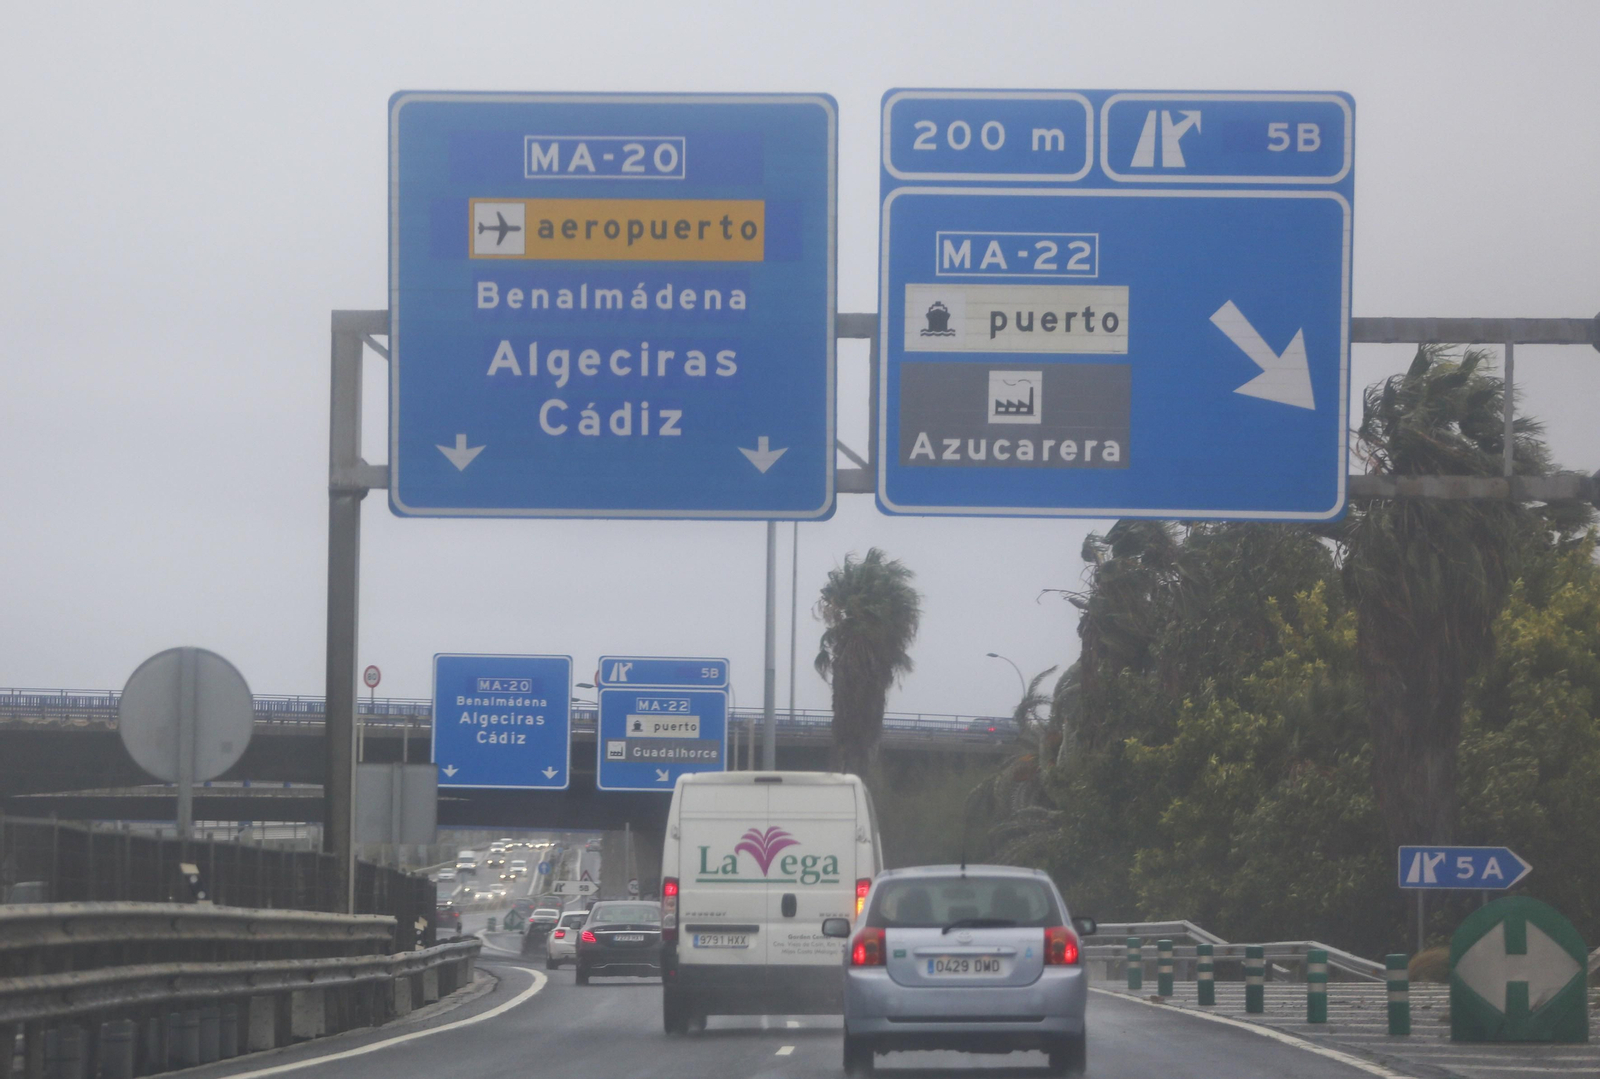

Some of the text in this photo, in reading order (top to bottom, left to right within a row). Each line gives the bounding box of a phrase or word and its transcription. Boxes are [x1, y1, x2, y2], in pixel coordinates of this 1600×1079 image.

[912, 119, 1065, 152] 200 m
[1266, 122, 1322, 153] 5B
[530, 142, 679, 173] MA-20
[537, 214, 758, 246] aeropuerto
[942, 239, 1092, 271] MA-22
[477, 281, 747, 310] Benalmádena
[989, 305, 1120, 340] puerto
[486, 340, 738, 389] Algeciras
[538, 398, 683, 436] Cádiz
[909, 432, 1121, 462] Azucarera
[479, 680, 530, 692] MA-20
[701, 668, 719, 678] 5B
[456, 695, 548, 708] Benalmádena
[638, 700, 688, 711] MA-22
[459, 711, 545, 728] Algeciras
[653, 721, 698, 733] puerto
[476, 730, 526, 744] Cádiz
[633, 747, 718, 758] Guadalhorce
[697, 845, 740, 875] La
[700, 935, 747, 945] 9791 HXX
[936, 959, 969, 972] 0429
